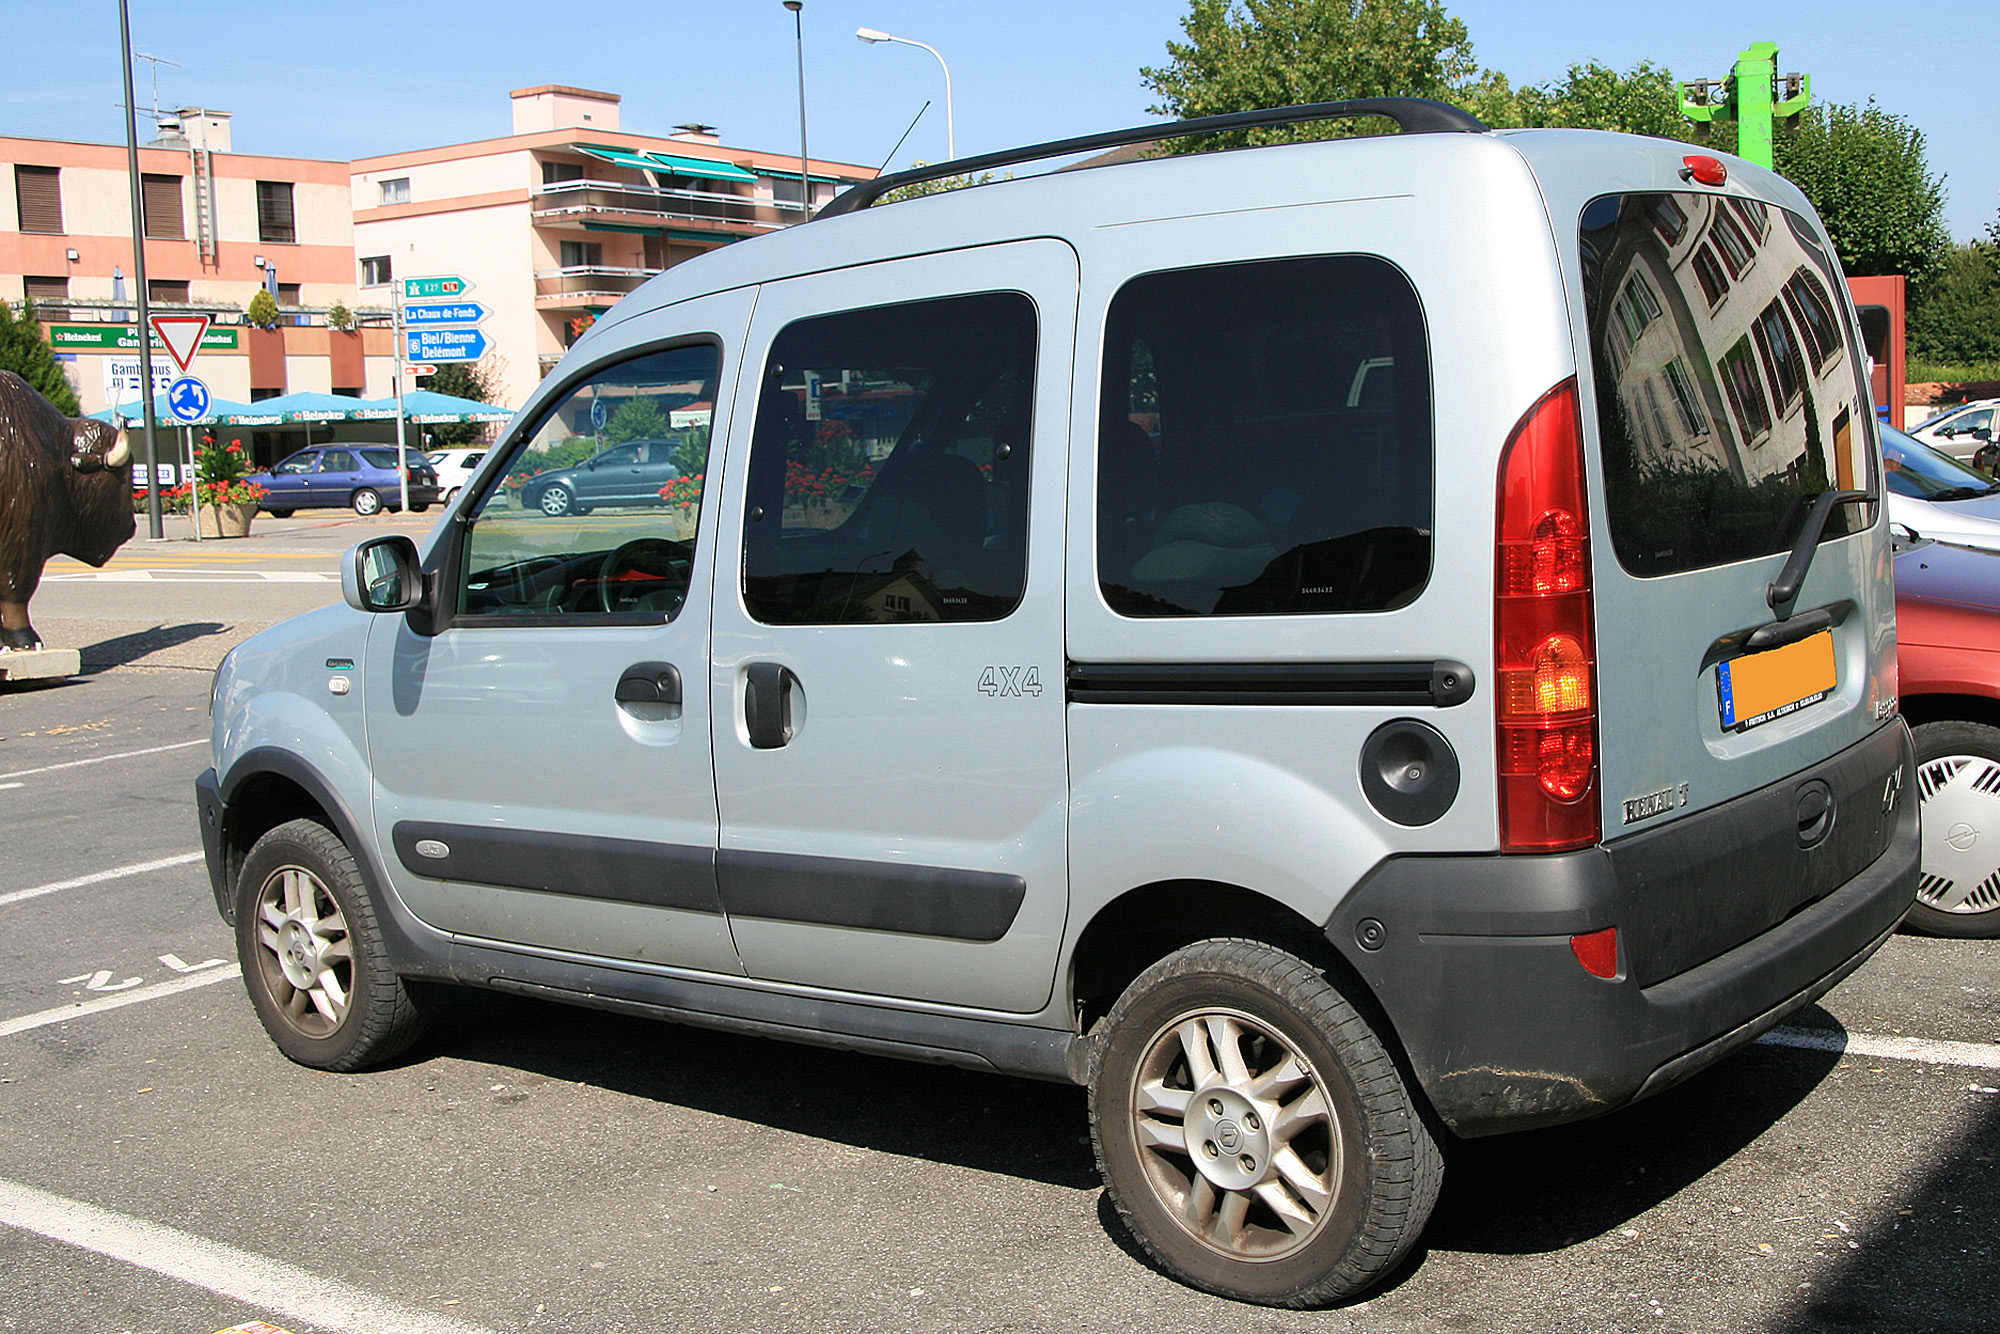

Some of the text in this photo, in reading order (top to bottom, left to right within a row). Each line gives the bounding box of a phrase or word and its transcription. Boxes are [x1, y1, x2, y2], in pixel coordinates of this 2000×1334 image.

[406, 309, 416, 319] La
[64, 333, 102, 342] Heineken
[202, 335, 232, 344] eineken
[421, 331, 476, 345] Biel/Bienne
[411, 341, 418, 351] 6
[422, 345, 466, 358] Delémont
[112, 363, 171, 375] Gambnus
[302, 410, 345, 421] Heineken
[363, 409, 398, 419] Heineke
[419, 414, 460, 424] Heineken
[237, 415, 282, 425] Heineken
[977, 666, 1043, 697] 4X4
[1725, 701, 1731, 715] F
